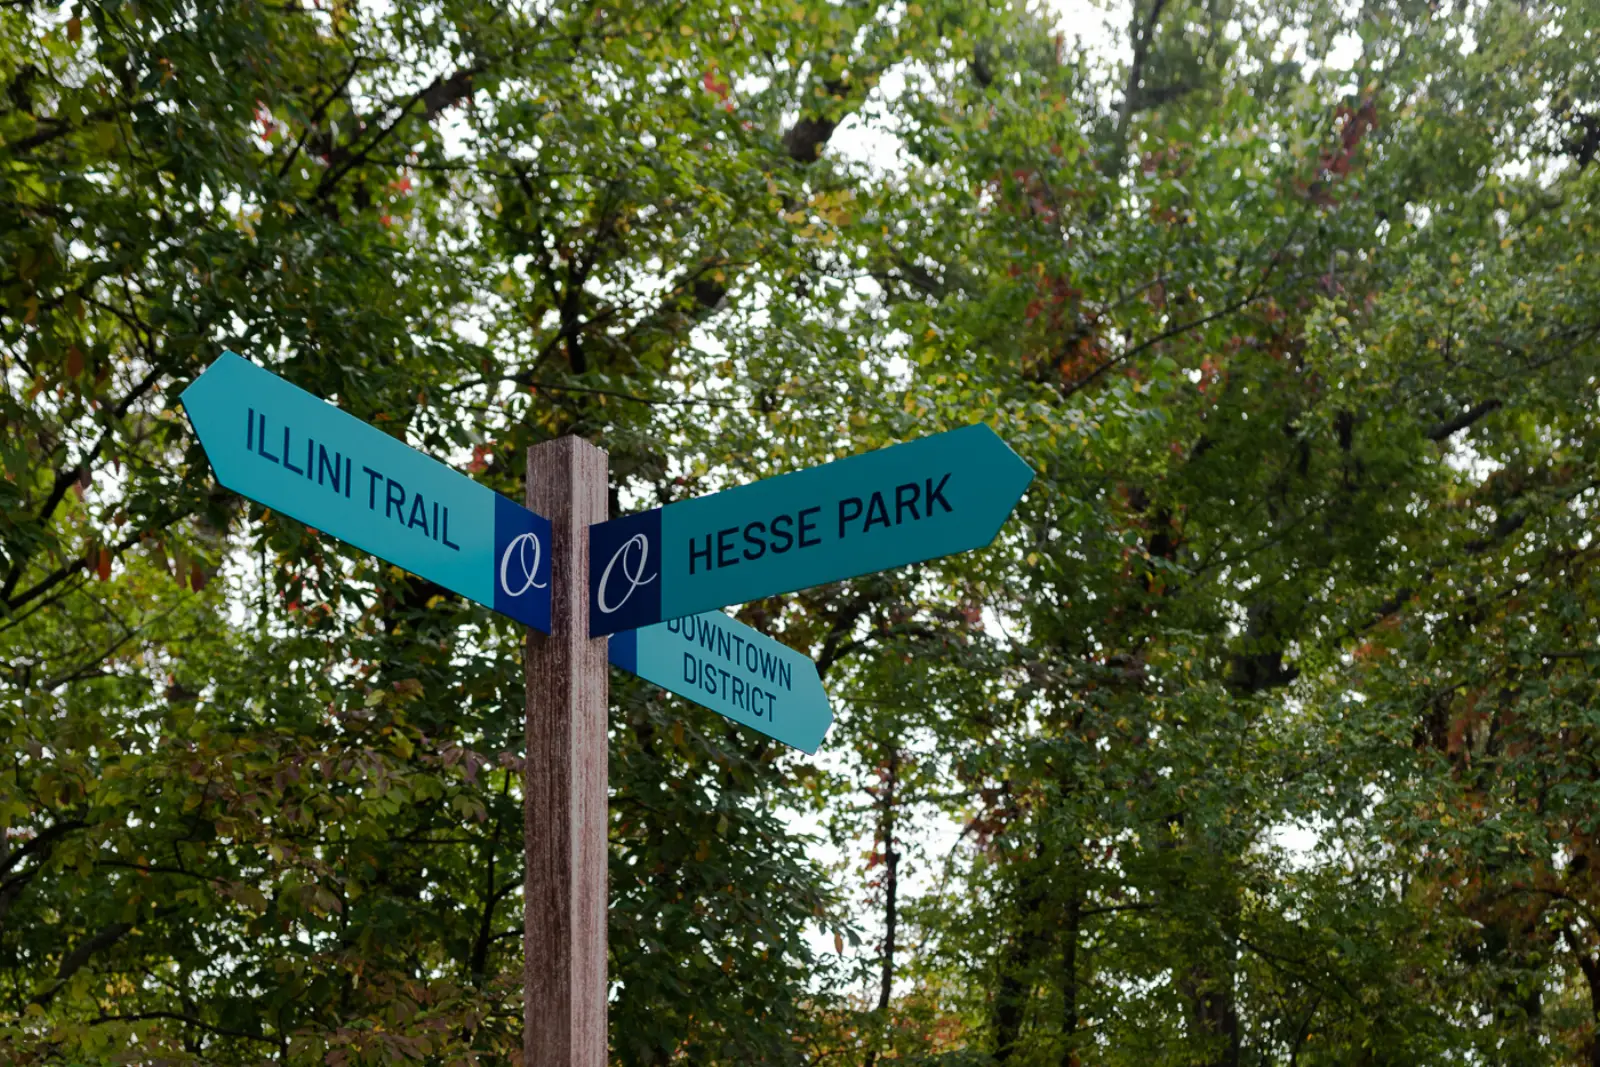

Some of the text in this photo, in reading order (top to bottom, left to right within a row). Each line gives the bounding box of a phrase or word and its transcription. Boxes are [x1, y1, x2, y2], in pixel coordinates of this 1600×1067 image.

[247, 407, 461, 552] ILLINI TRAIL
[688, 472, 953, 576] HESSE PARK
[683, 652, 777, 723] DISTRICT
